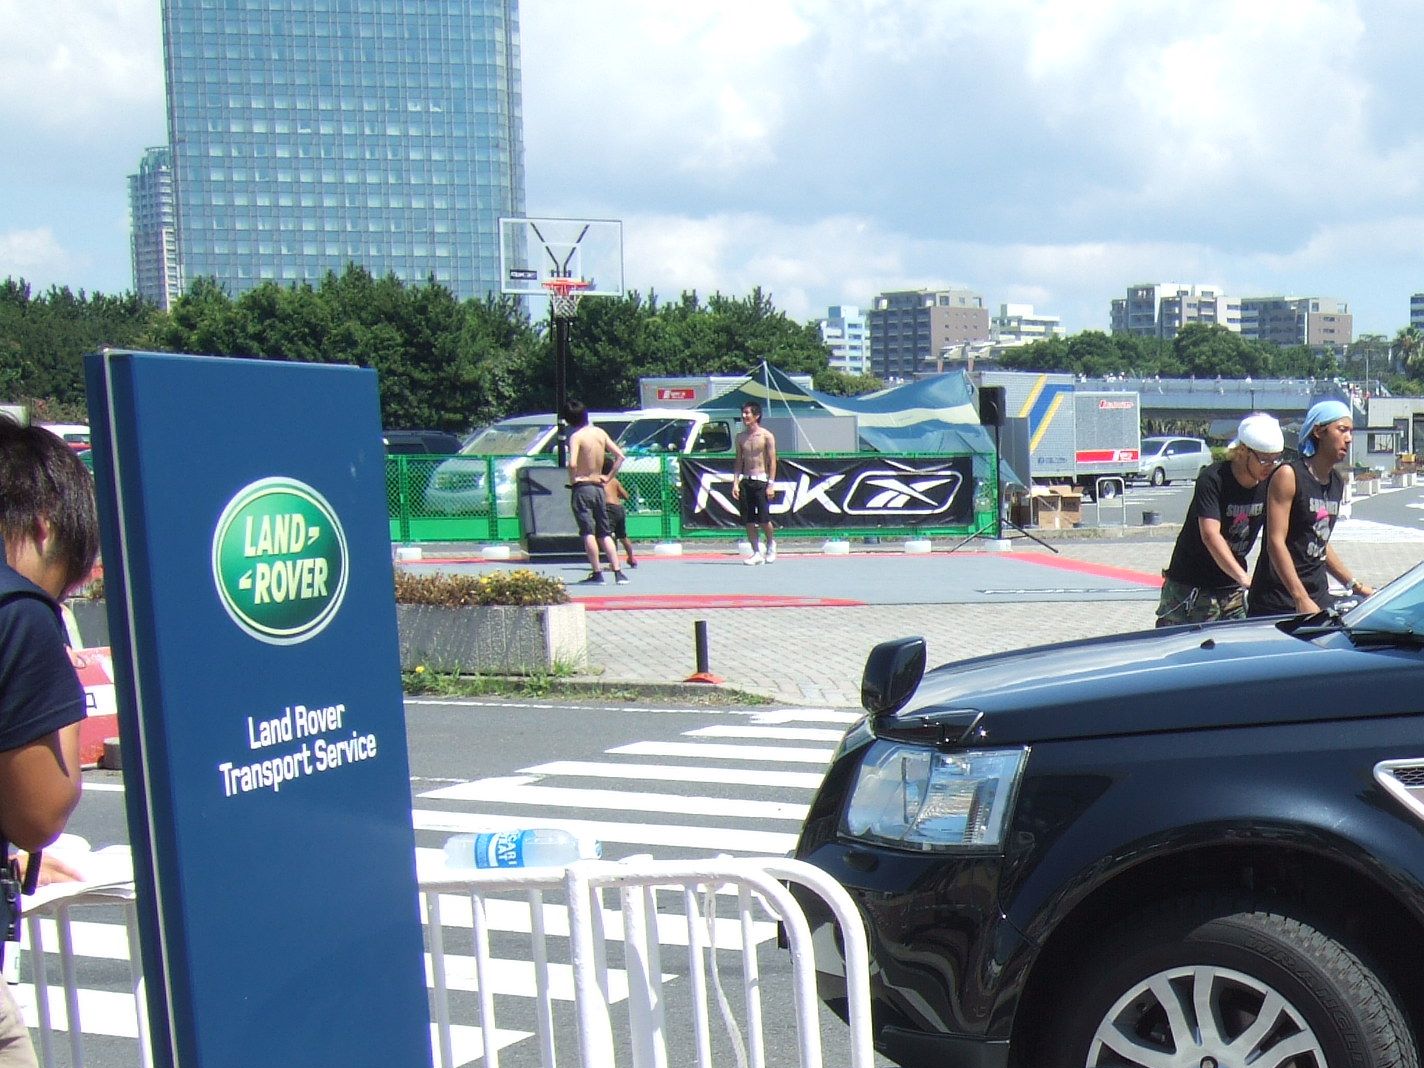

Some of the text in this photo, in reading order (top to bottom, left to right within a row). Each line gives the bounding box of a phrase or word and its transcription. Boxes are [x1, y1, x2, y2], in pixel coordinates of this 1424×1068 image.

[247, 703, 346, 750] Land Rover
[218, 730, 377, 797] Transport Service
